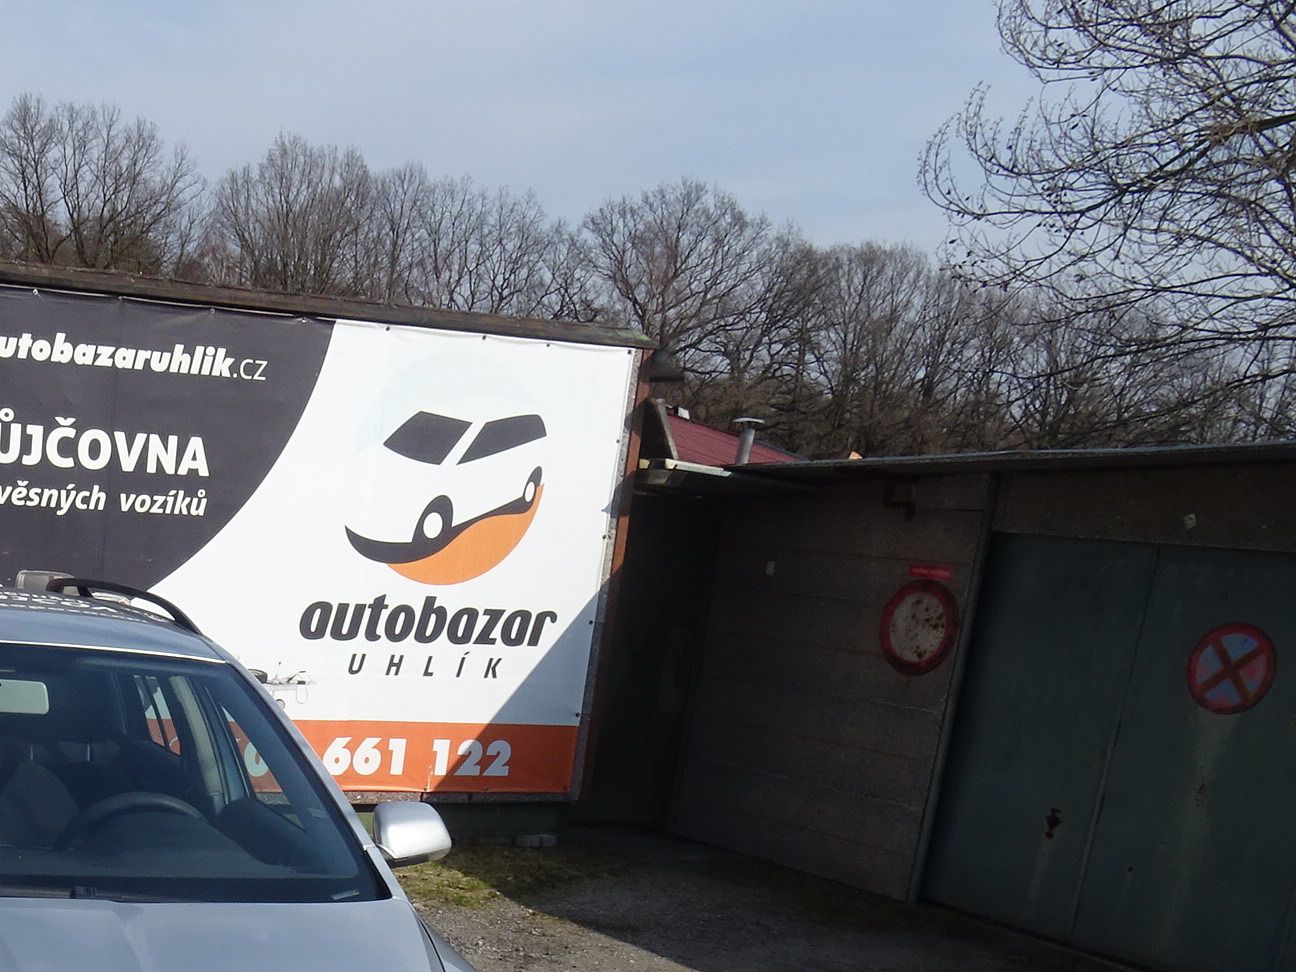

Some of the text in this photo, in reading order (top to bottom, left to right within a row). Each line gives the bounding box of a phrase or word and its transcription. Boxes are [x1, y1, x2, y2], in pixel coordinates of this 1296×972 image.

[119, 488, 208, 517] vozíků
[299, 594, 557, 647] autobazar
[348, 651, 503, 679] UHLÍK
[322, 737, 513, 777] 661 122
